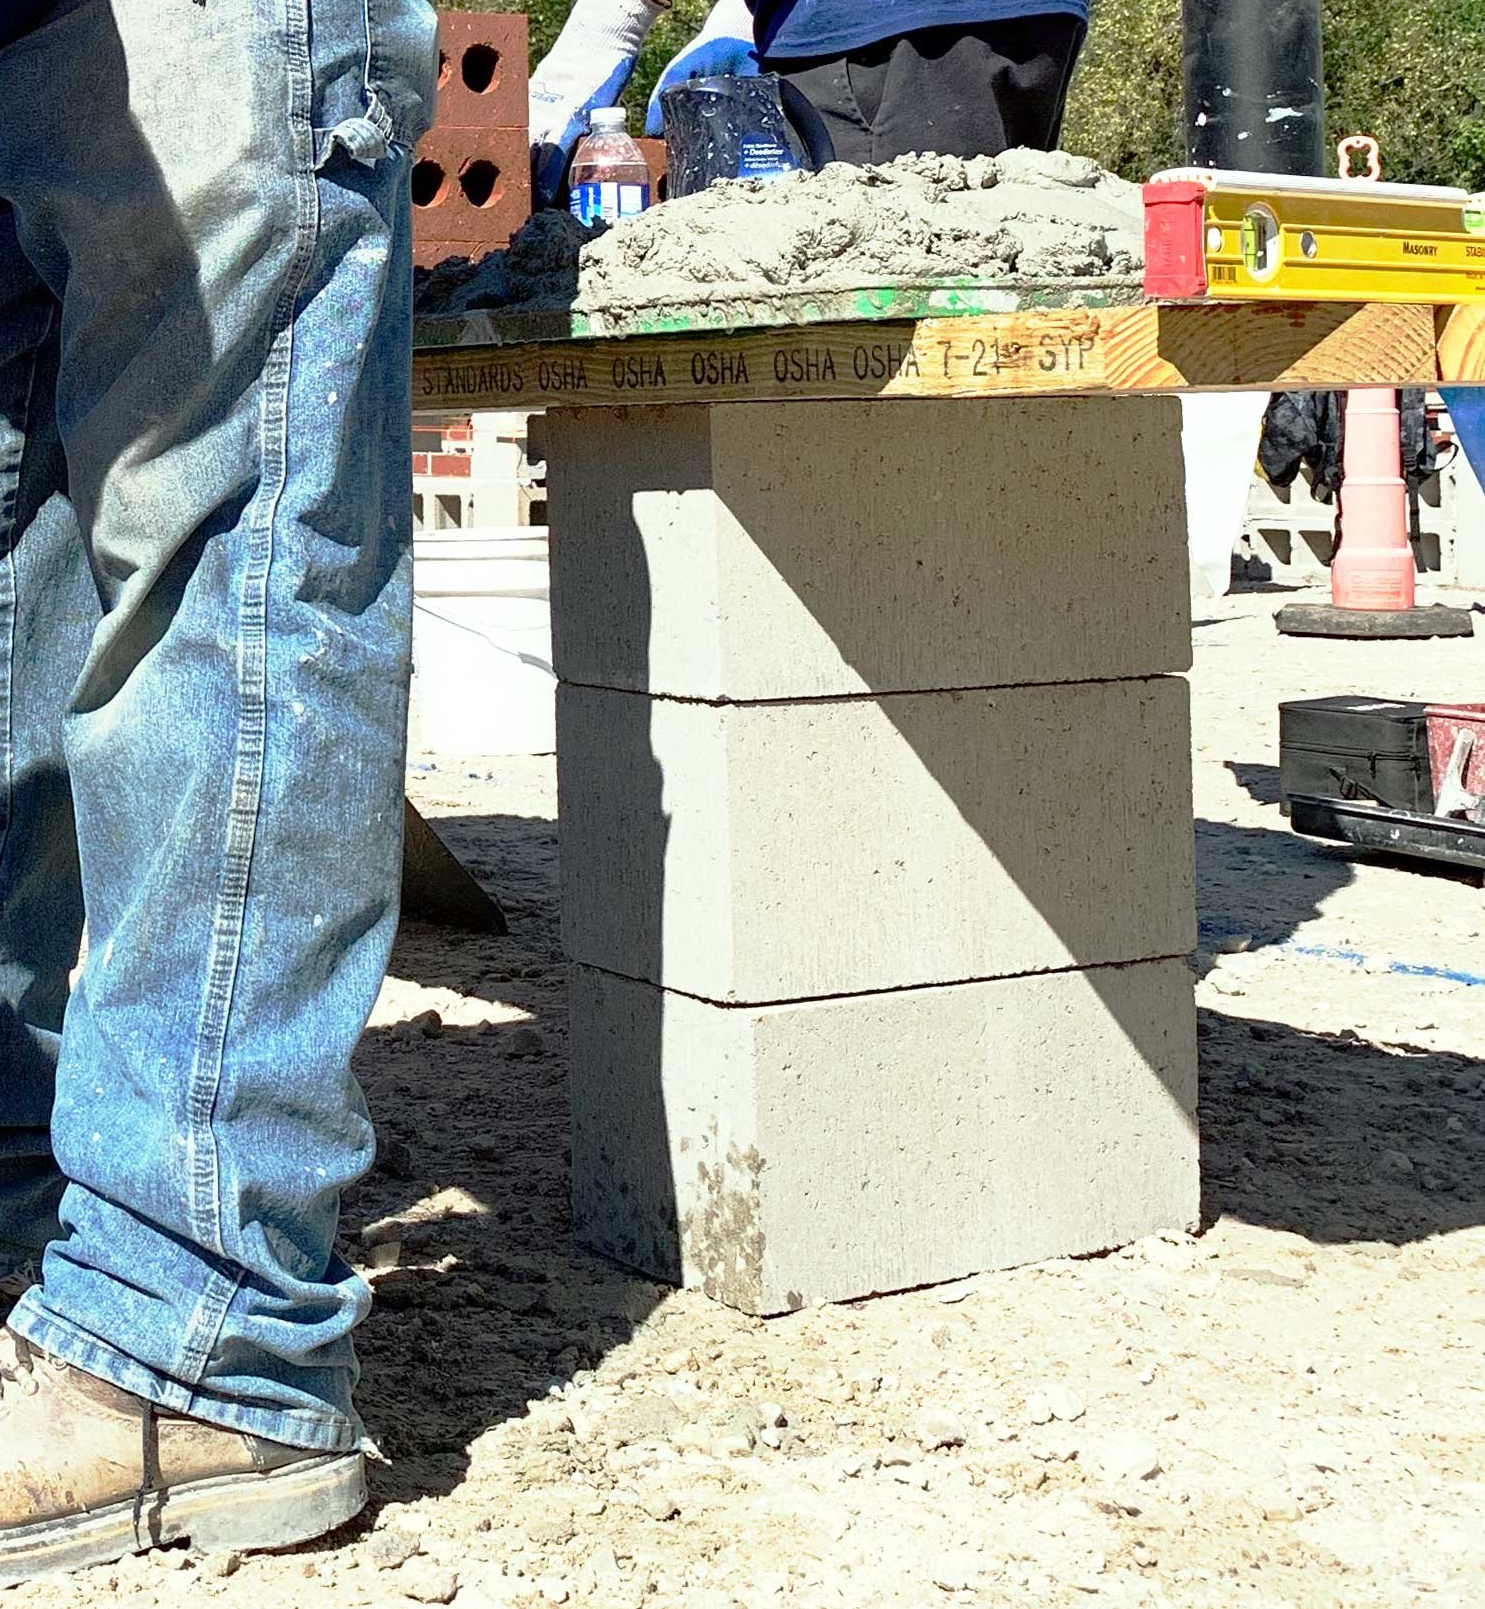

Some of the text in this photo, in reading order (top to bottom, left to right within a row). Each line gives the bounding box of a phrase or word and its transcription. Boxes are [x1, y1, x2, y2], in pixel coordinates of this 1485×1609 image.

[422, 363, 524, 395] STANDARDS
[538, 359, 588, 391] OSHA
[612, 356, 666, 389] OSHA
[691, 352, 749, 385] OSHA
[773, 348, 836, 382] OSHA
[853, 344, 920, 380] OSHA
